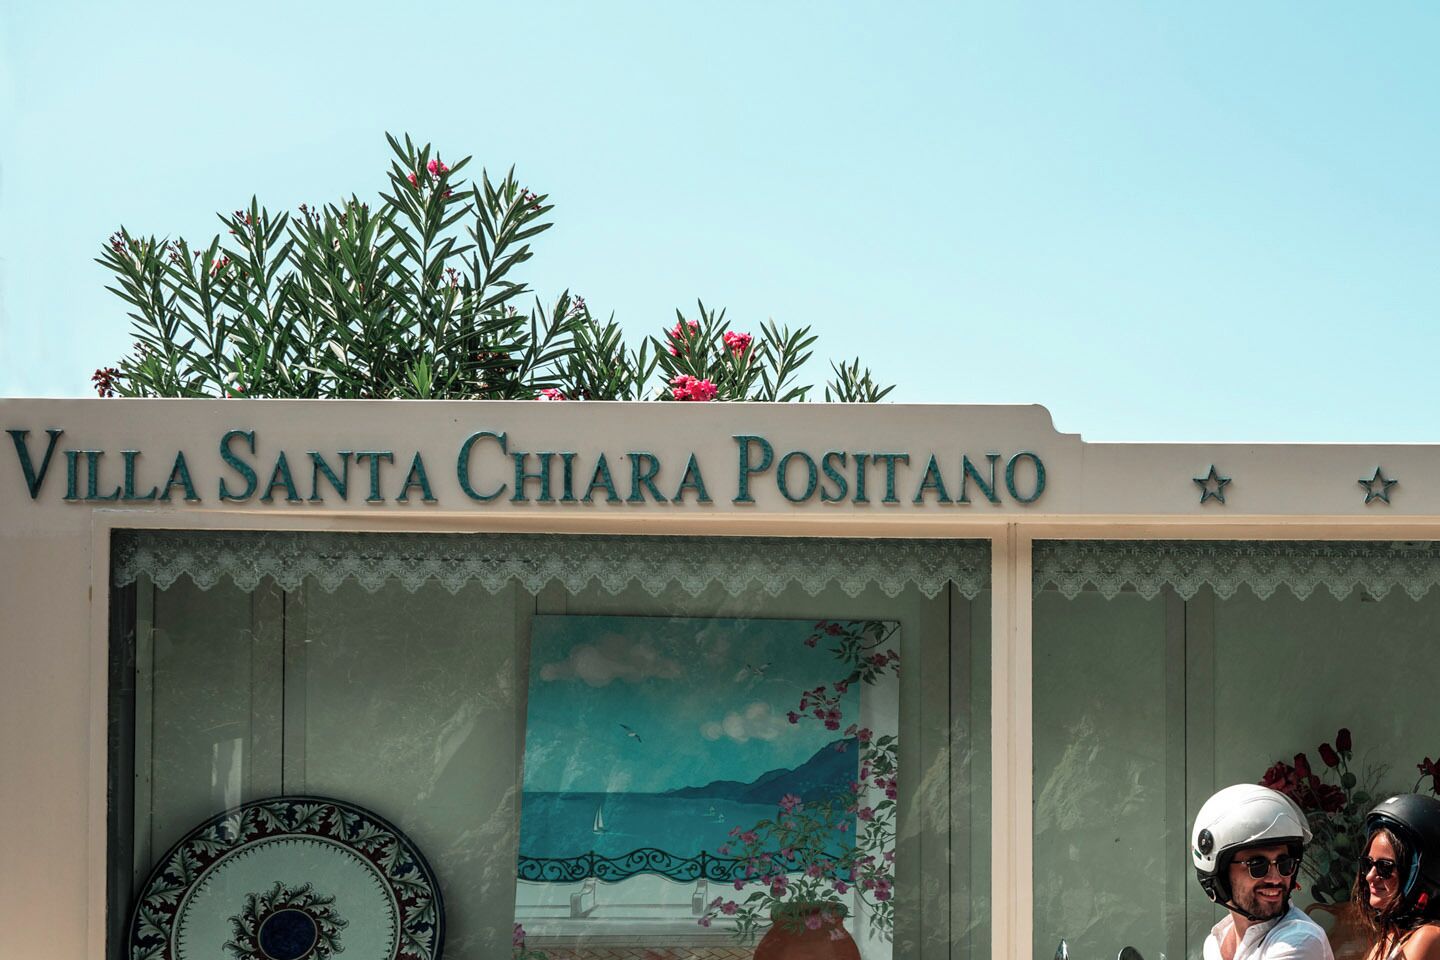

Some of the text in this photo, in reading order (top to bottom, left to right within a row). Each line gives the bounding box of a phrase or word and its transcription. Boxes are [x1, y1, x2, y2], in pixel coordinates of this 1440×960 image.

[6, 428, 1047, 504] VILLA SANTA CHIARA POSITANO
